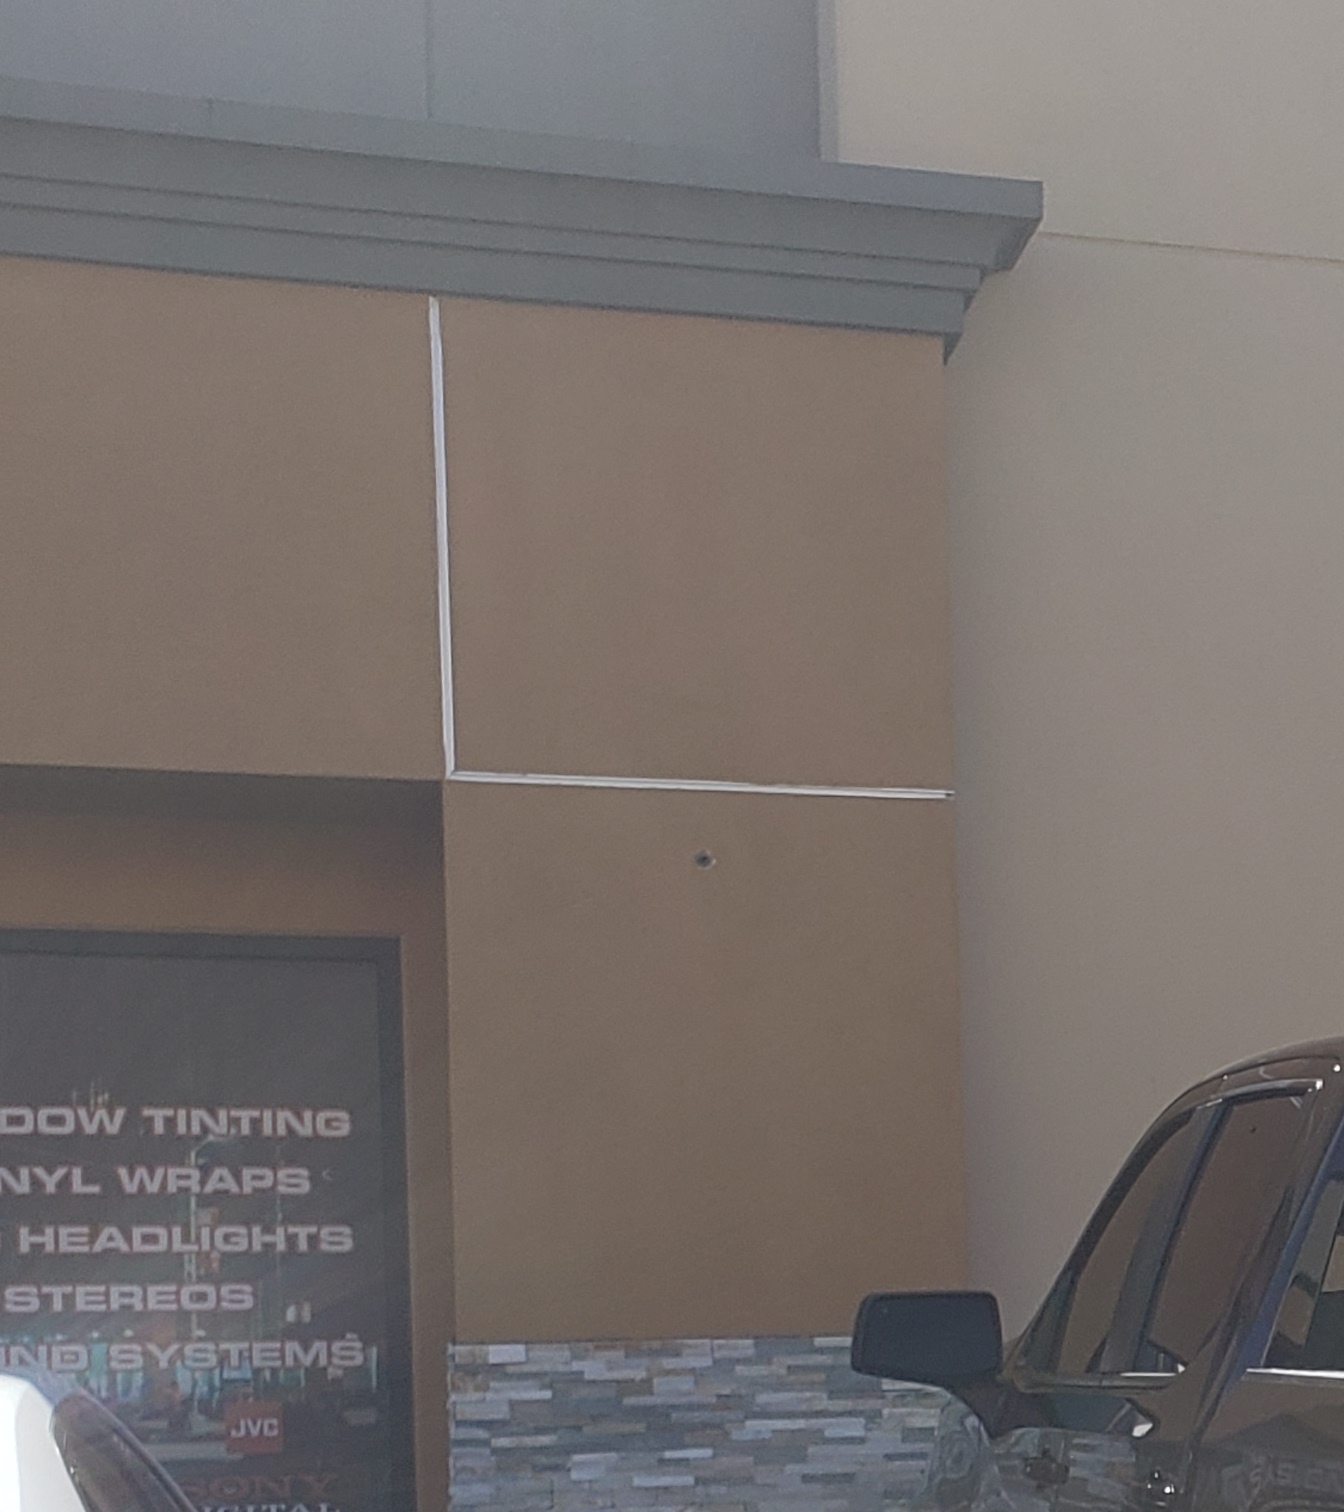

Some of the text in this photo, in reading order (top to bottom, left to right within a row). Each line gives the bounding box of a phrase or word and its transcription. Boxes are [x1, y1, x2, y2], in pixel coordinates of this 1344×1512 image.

[142, 1107, 351, 1137] TINTING
[117, 1166, 311, 1195] WRAPS
[18, 1225, 354, 1254] HEADLIGHTS
[4, 1284, 254, 1313] STEREOS
[0, 1340, 364, 1371] ND SYSTEMS
[230, 1417, 279, 1438] JVC
[181, 1474, 339, 1500] SONY
